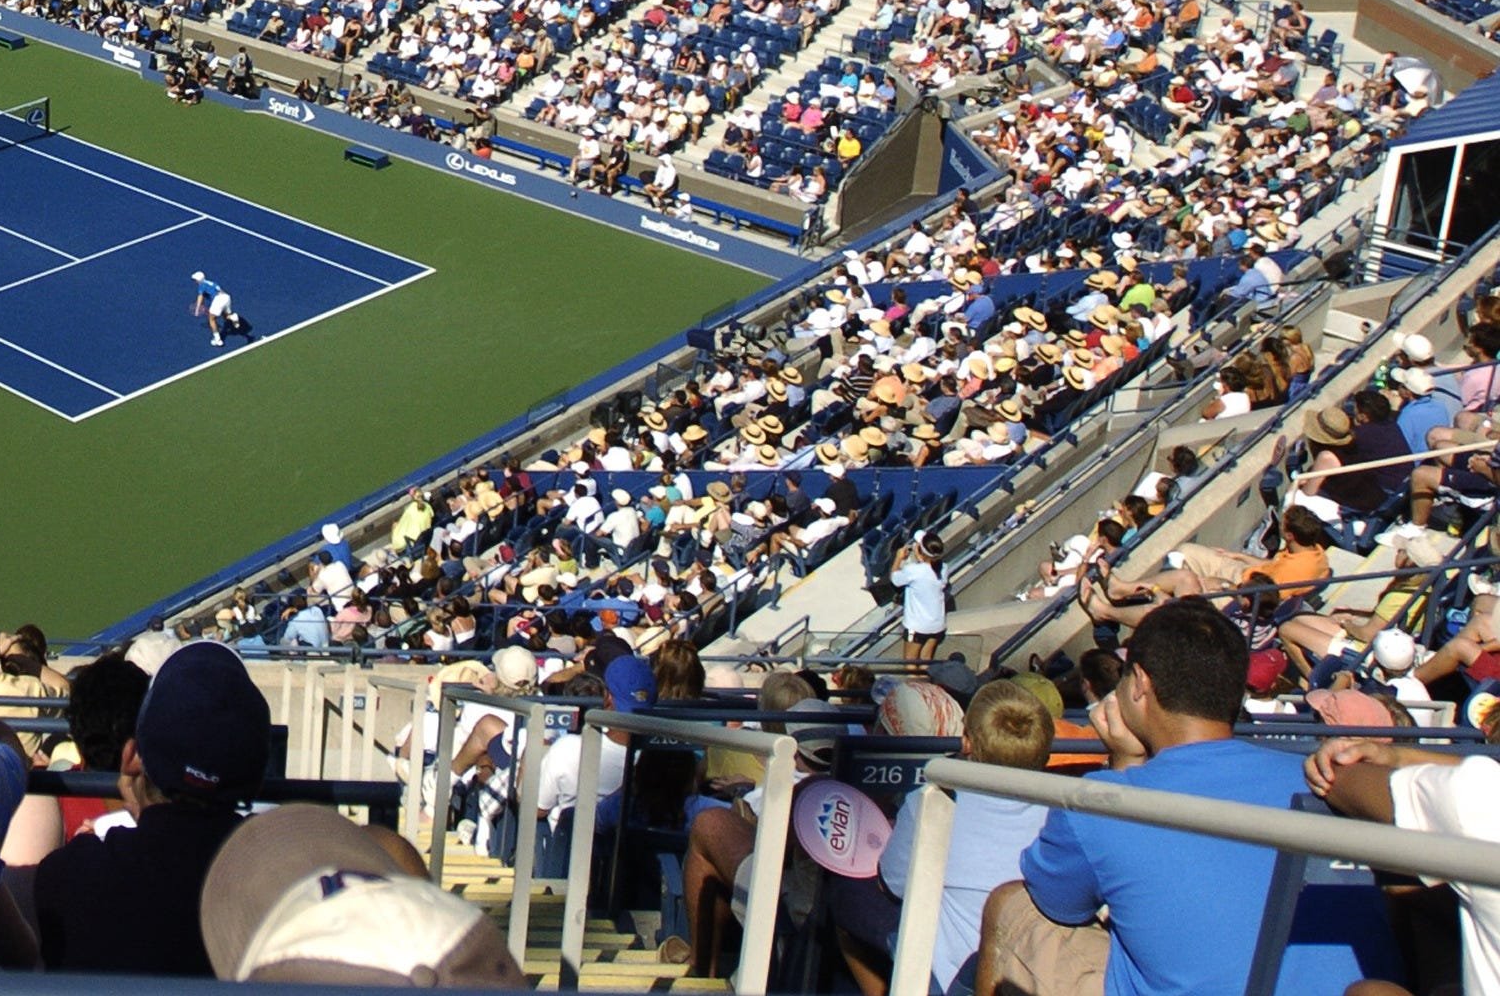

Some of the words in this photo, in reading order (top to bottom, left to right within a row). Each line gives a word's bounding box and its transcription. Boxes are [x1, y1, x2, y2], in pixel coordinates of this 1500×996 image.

[268, 97, 299, 119] Sprint
[464, 160, 517, 185] LEXUS
[558, 713, 571, 727] C
[185, 765, 220, 784] POLO
[862, 765, 903, 784] 216
[829, 800, 851, 851] evian
